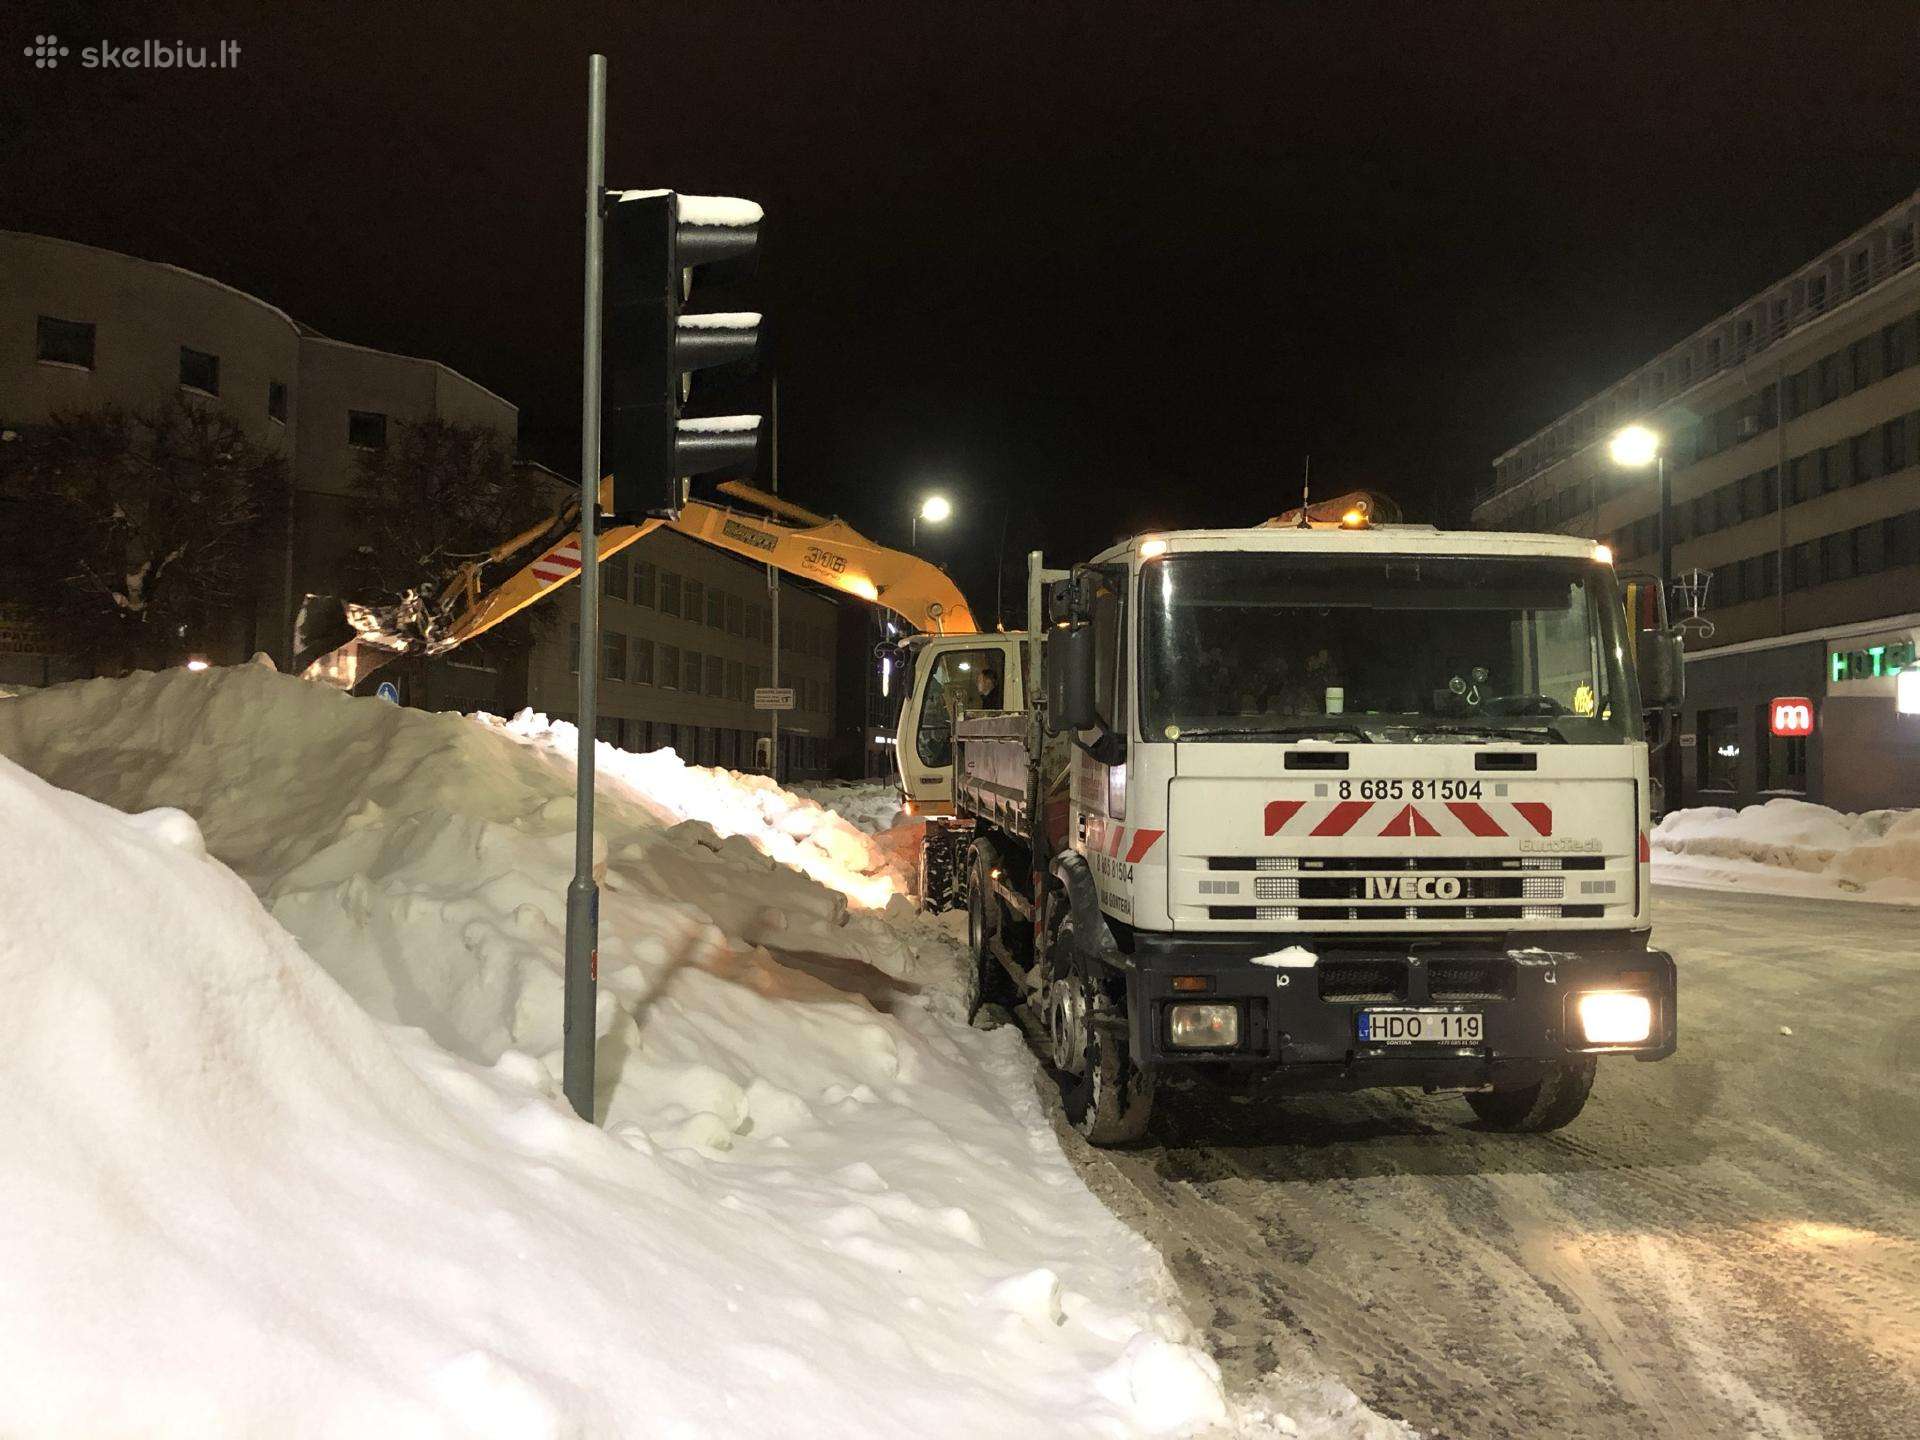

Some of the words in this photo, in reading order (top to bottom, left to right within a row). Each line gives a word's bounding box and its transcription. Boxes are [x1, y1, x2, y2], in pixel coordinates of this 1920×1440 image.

[1339, 780, 1351, 799] 8
[1360, 779, 1402, 799] 685
[1411, 779, 1483, 799] 81504
[1365, 877, 1461, 899] IVECO
[1373, 1017, 1422, 1038] HDO
[1441, 1017, 1479, 1038] 119
